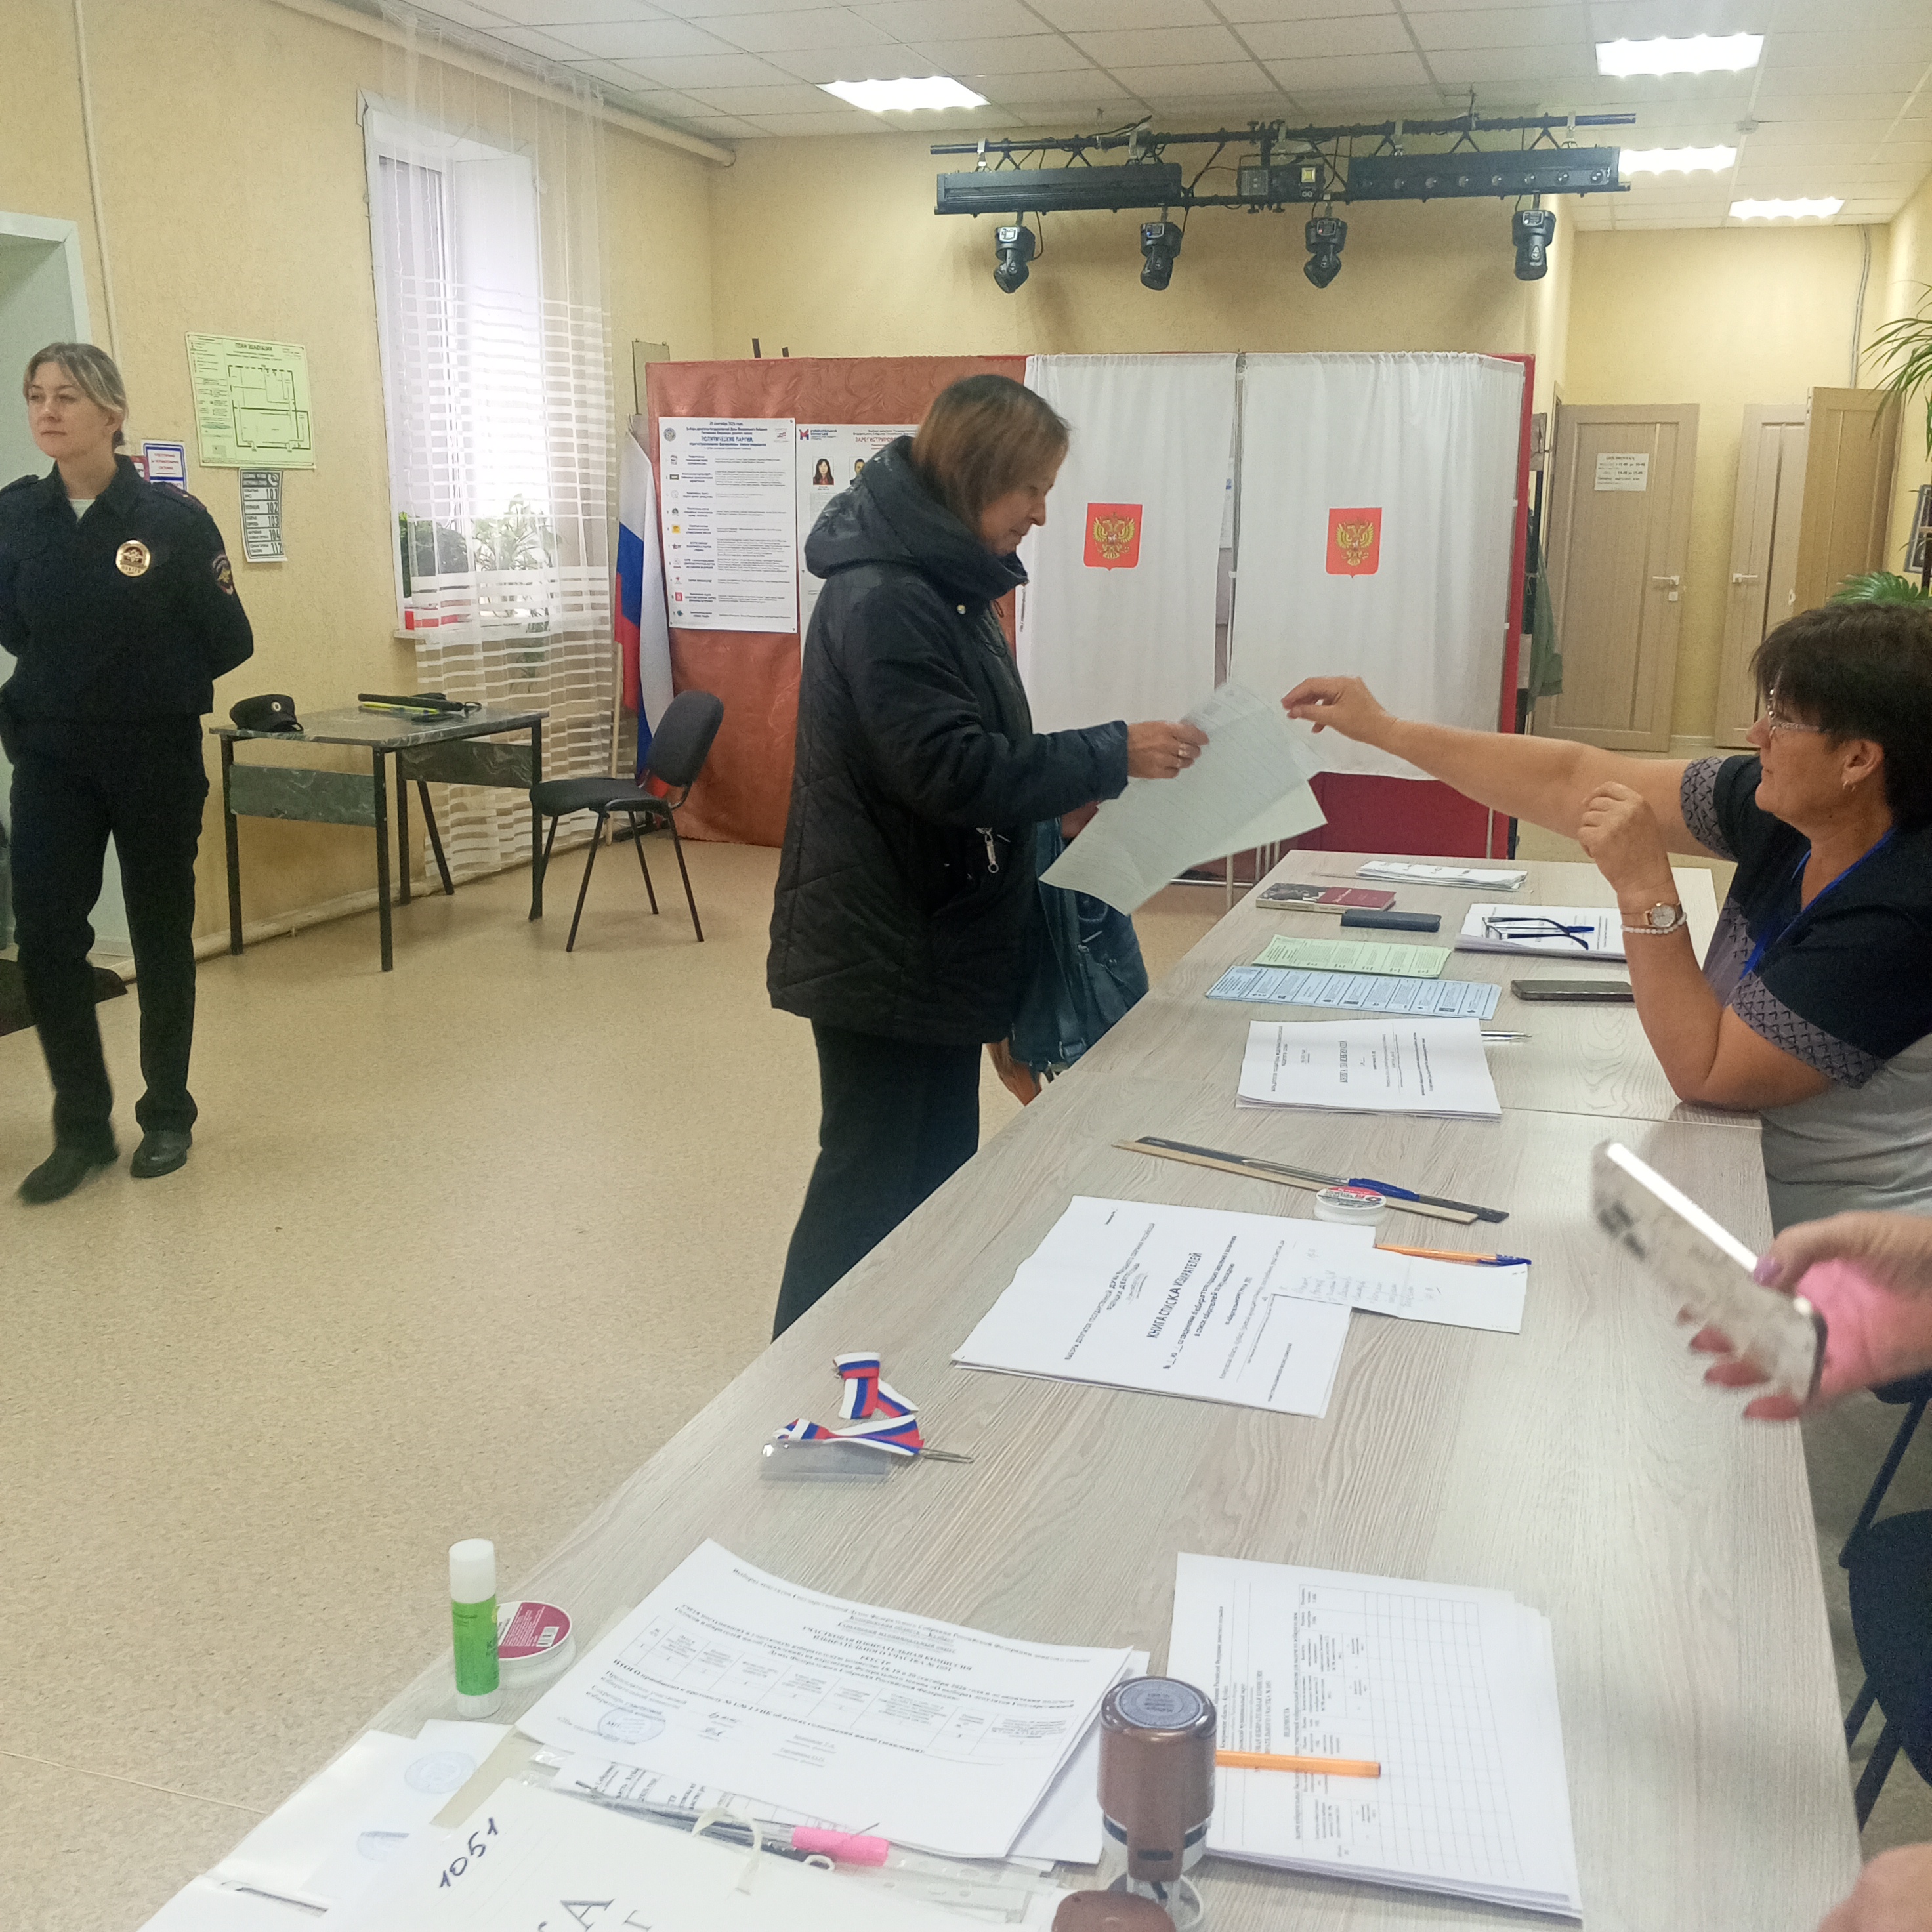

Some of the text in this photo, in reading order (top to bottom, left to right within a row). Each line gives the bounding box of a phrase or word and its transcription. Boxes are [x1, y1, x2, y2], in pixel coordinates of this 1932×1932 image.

[266, 488, 278, 500] 101
[267, 502, 278, 513] 102
[268, 516, 278, 527] 103
[269, 529, 280, 541] 104
[271, 542, 283, 554] 112
[1147, 1253, 1202, 1338] КНИГА СПИСКА ИЗБИРАТЕЛЕЙ
[440, 1817, 498, 1887] 1051
